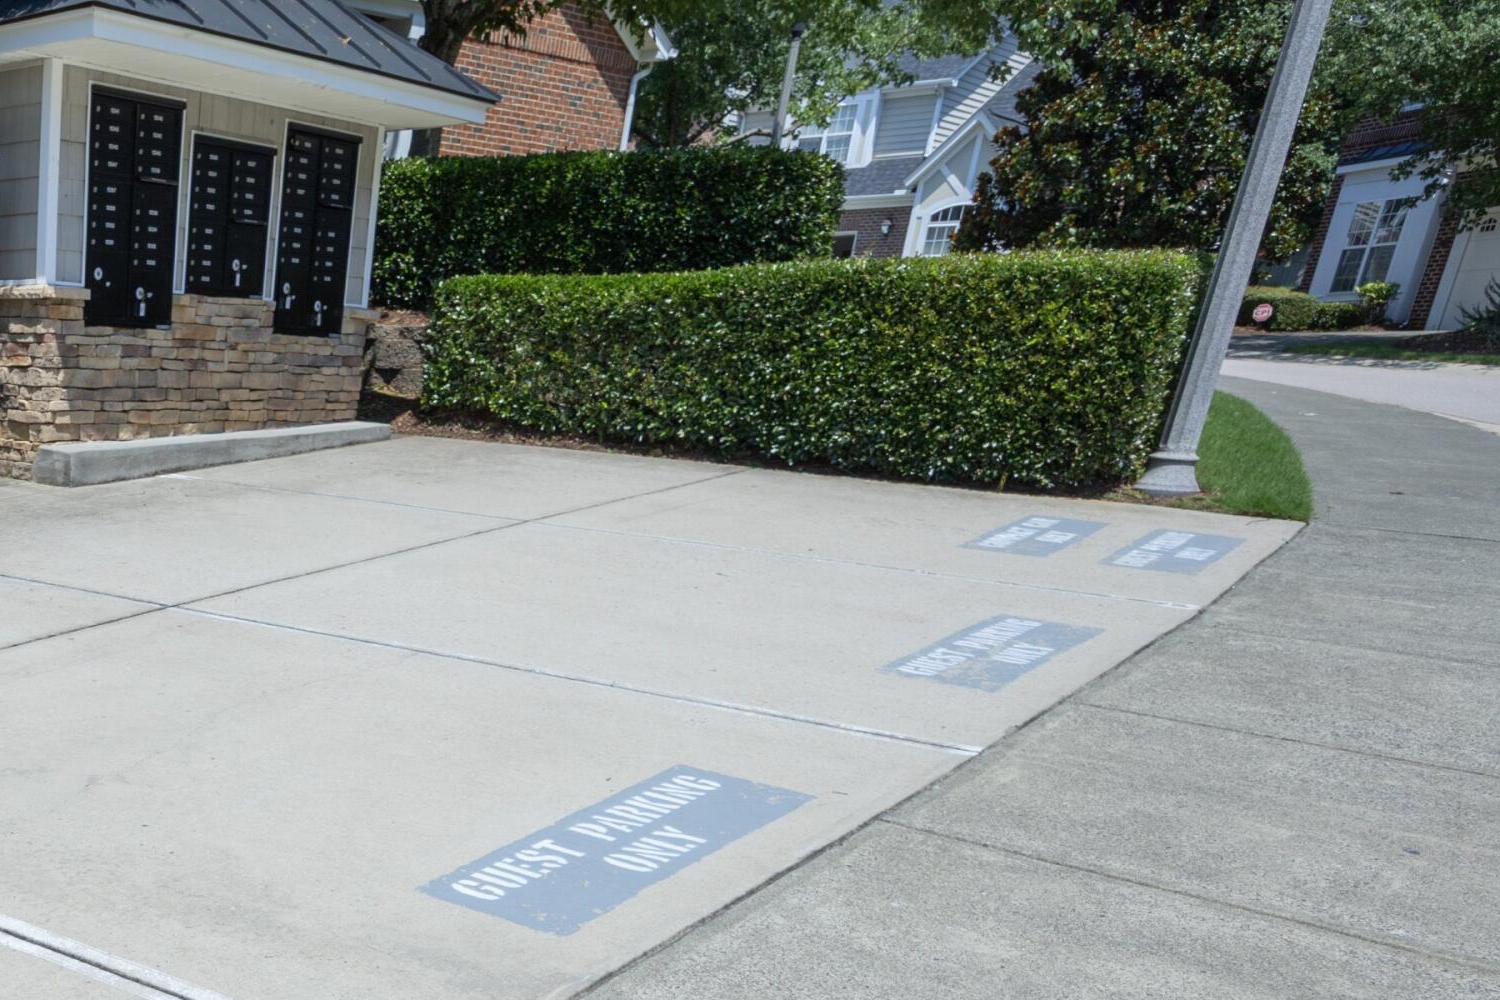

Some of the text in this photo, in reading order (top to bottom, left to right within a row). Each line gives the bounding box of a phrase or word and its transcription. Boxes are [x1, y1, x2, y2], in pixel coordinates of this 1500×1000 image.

[897, 618, 1043, 676] GUEST PARKING
[991, 641, 1055, 665] ONLY
[451, 774, 721, 900] GUEST PARKING
[603, 825, 707, 873] ONLY
